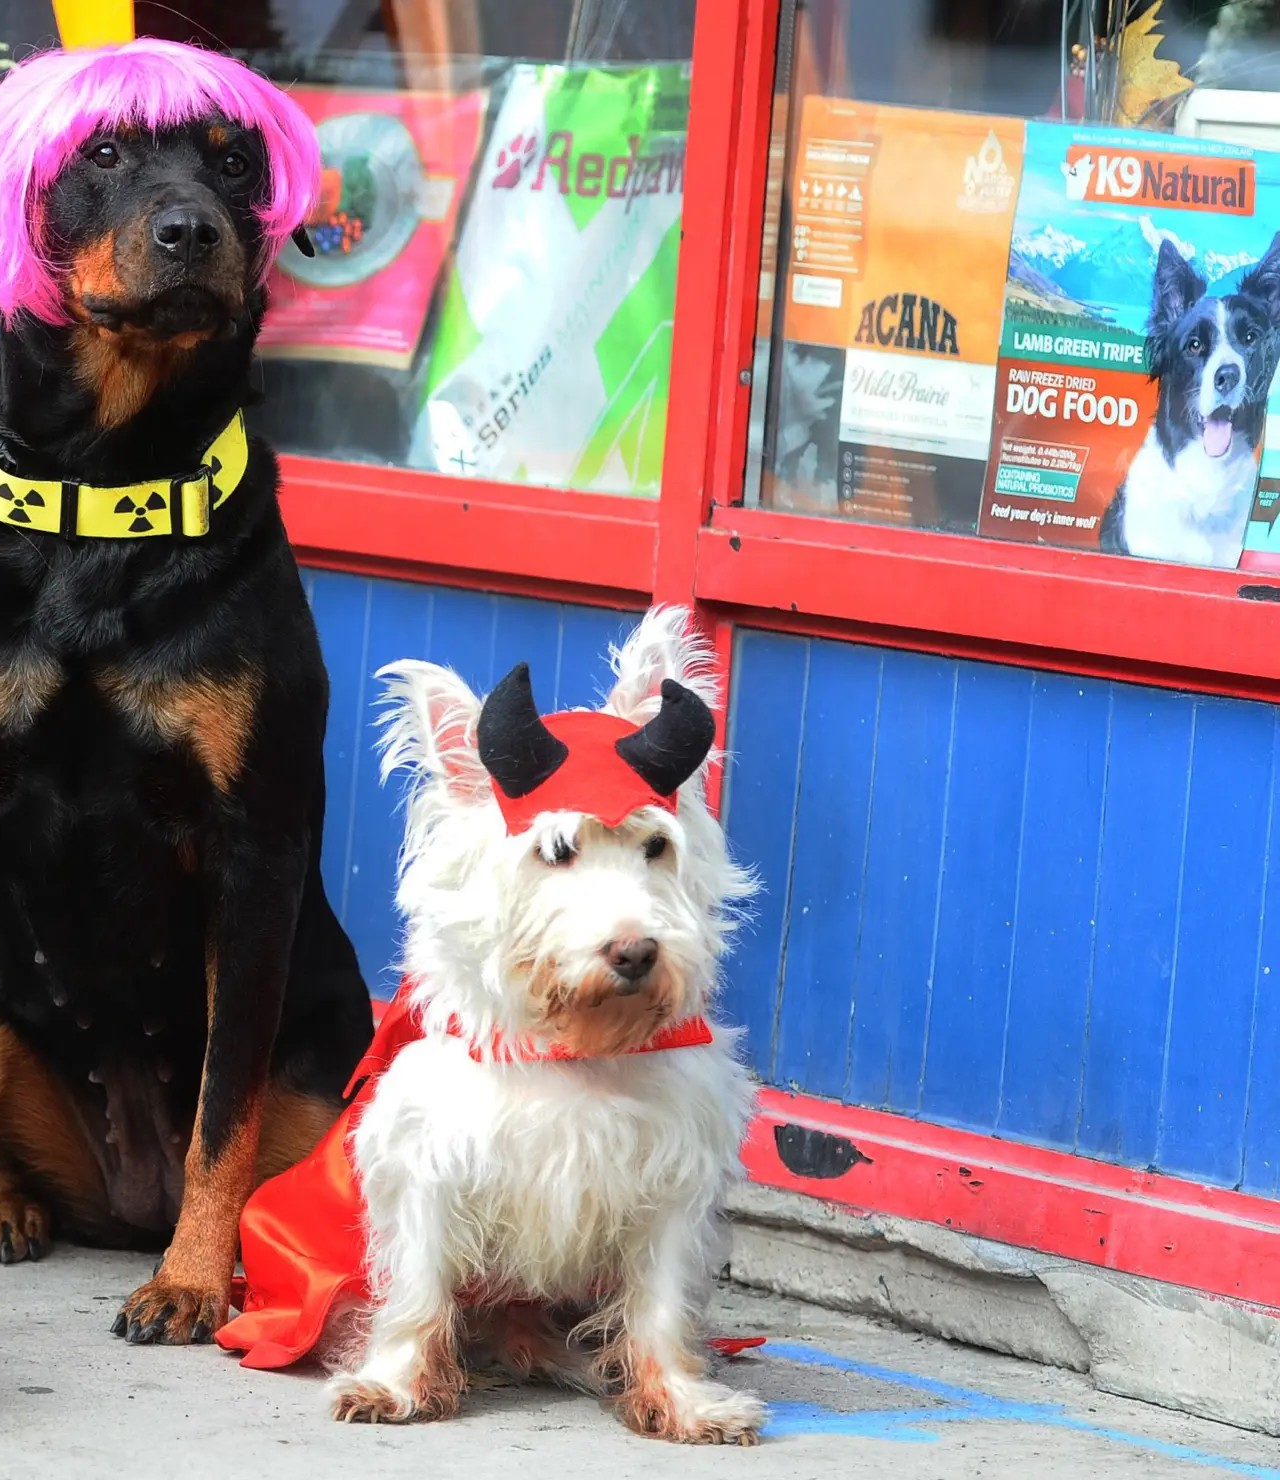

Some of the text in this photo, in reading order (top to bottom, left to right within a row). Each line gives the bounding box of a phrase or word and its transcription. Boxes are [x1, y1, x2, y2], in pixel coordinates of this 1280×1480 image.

[855, 292, 960, 356] ACANA
[1014, 331, 1143, 364] LAMB GREEN TRIPE
[850, 365, 950, 406] Wild Prairie
[1009, 368, 1096, 392] RAW FREEZE DRIED
[1006, 383, 1138, 427] DOG FOOD
[998, 479, 1074, 498] NATURAL PROBIOTICS
[1000, 467, 1041, 483] CONTAINING
[990, 503, 1010, 518] Feed
[1010, 508, 1030, 521] your
[1030, 508, 1052, 526] dog's
[1053, 511, 1075, 526] inner
